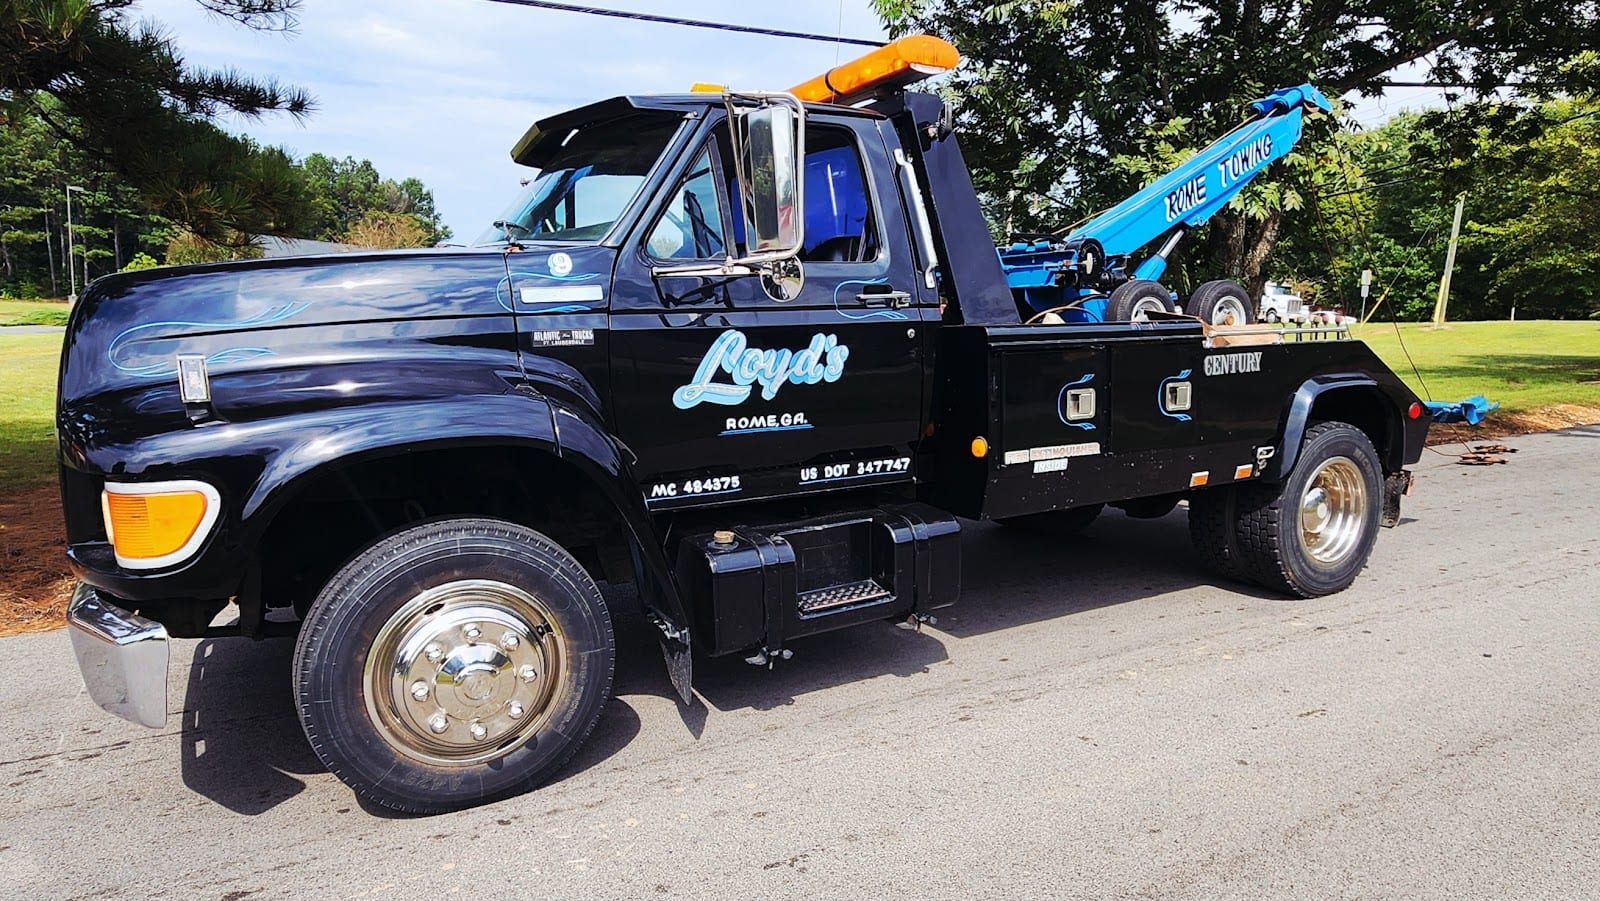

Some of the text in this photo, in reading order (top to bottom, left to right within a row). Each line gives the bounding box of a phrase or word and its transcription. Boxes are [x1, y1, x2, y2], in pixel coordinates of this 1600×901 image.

[1164, 133, 1272, 222] ROME TOWING
[547, 252, 573, 277] 9
[533, 330, 560, 341] ATLANTIC
[571, 329, 594, 340] TRUCKS
[672, 329, 850, 410] Loyd's
[1203, 351, 1263, 377] CENTURY
[800, 467, 818, 481] US
[824, 463, 850, 478] DOT
[651, 476, 741, 497] MC 484375
